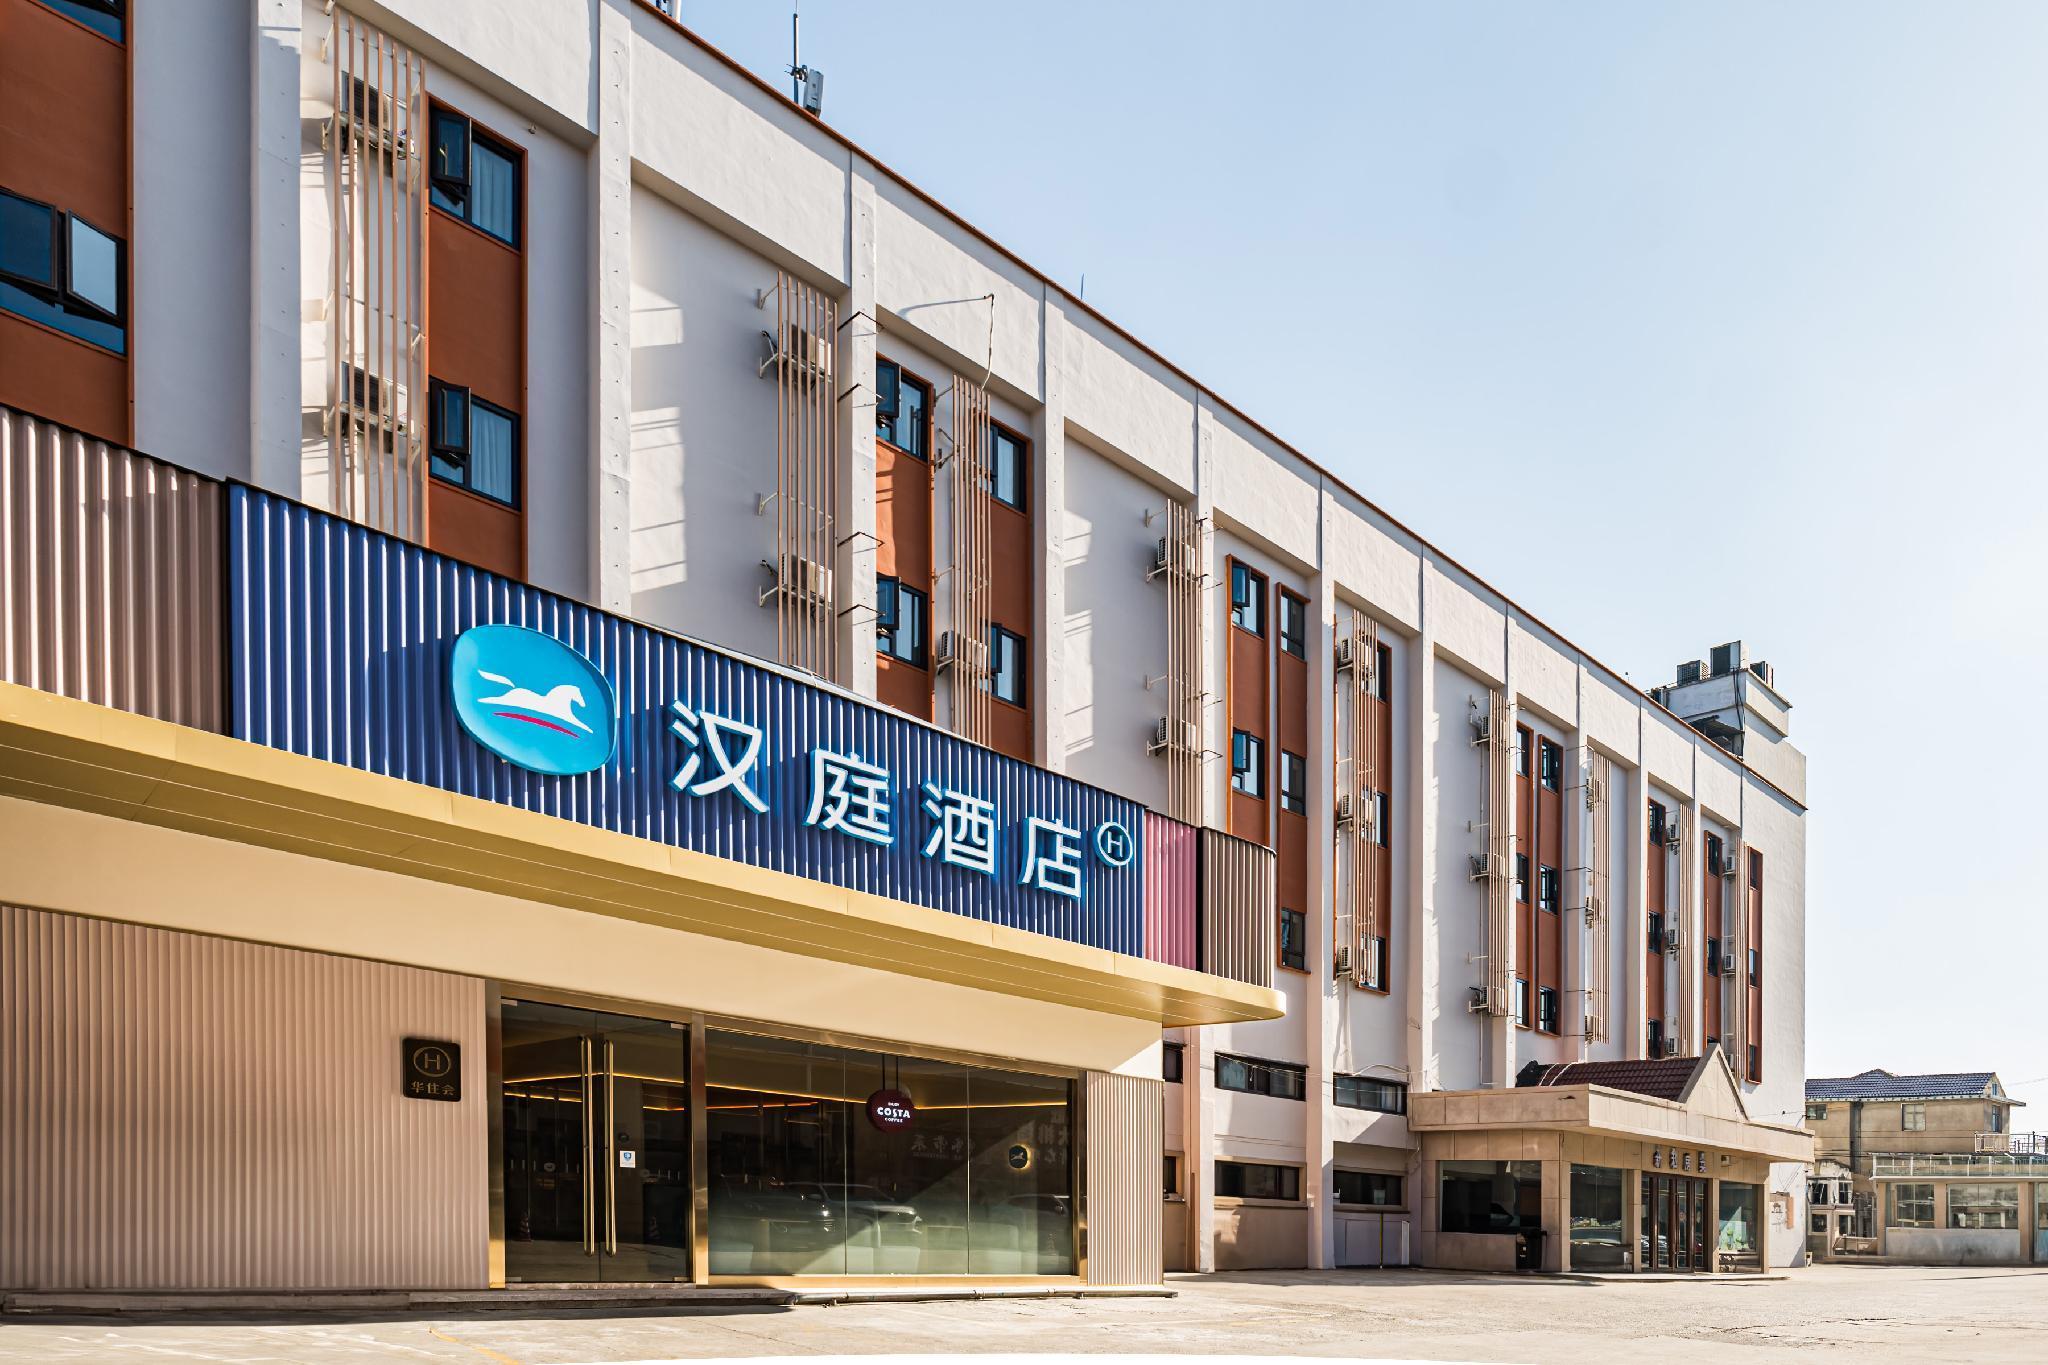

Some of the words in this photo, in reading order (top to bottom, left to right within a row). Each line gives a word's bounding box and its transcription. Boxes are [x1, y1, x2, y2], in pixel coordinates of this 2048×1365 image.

[668, 699, 1083, 899] 汉庭酒店
[411, 1081, 455, 1095] 华住会
[876, 1106, 911, 1119] COSTA
